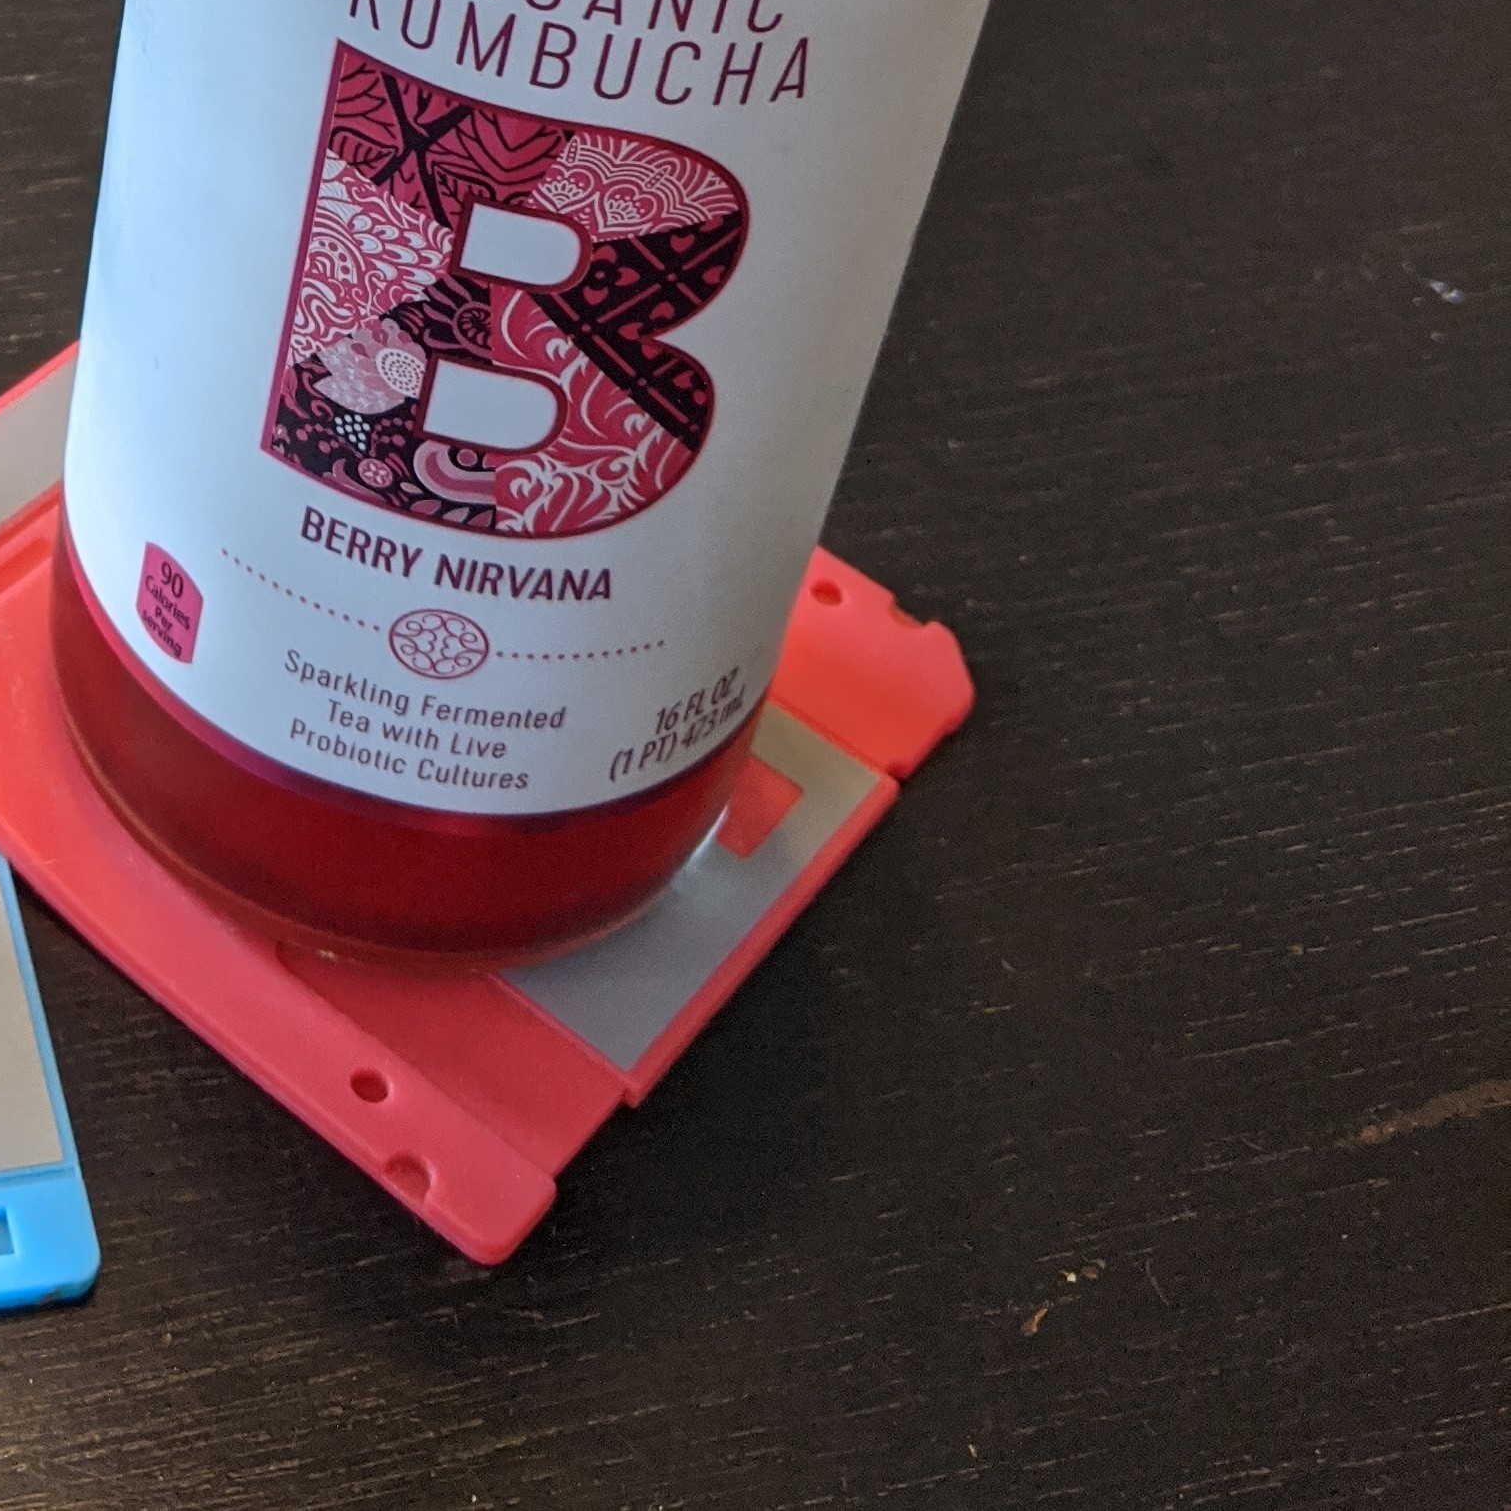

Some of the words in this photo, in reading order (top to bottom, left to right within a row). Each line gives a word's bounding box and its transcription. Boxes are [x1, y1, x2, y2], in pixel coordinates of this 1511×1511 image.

[260, 37, 750, 540] B
[161, 560, 184, 599] 90
[299, 505, 423, 579] BERRY
[434, 553, 613, 602] NIRVANA
[145, 574, 191, 630] Calories
[284, 649, 410, 716] Sparkling
[421, 695, 567, 731] Fermented
[655, 700, 682, 735] 16
[683, 687, 706, 722] FL
[289, 719, 407, 776] Probiotic
[417, 758, 530, 790] Cultures
[327, 699, 370, 735] Tea
[381, 717, 439, 753] with
[450, 726, 507, 761] Live
[609, 746, 634, 783] (1
[638, 731, 678, 769] PT)
